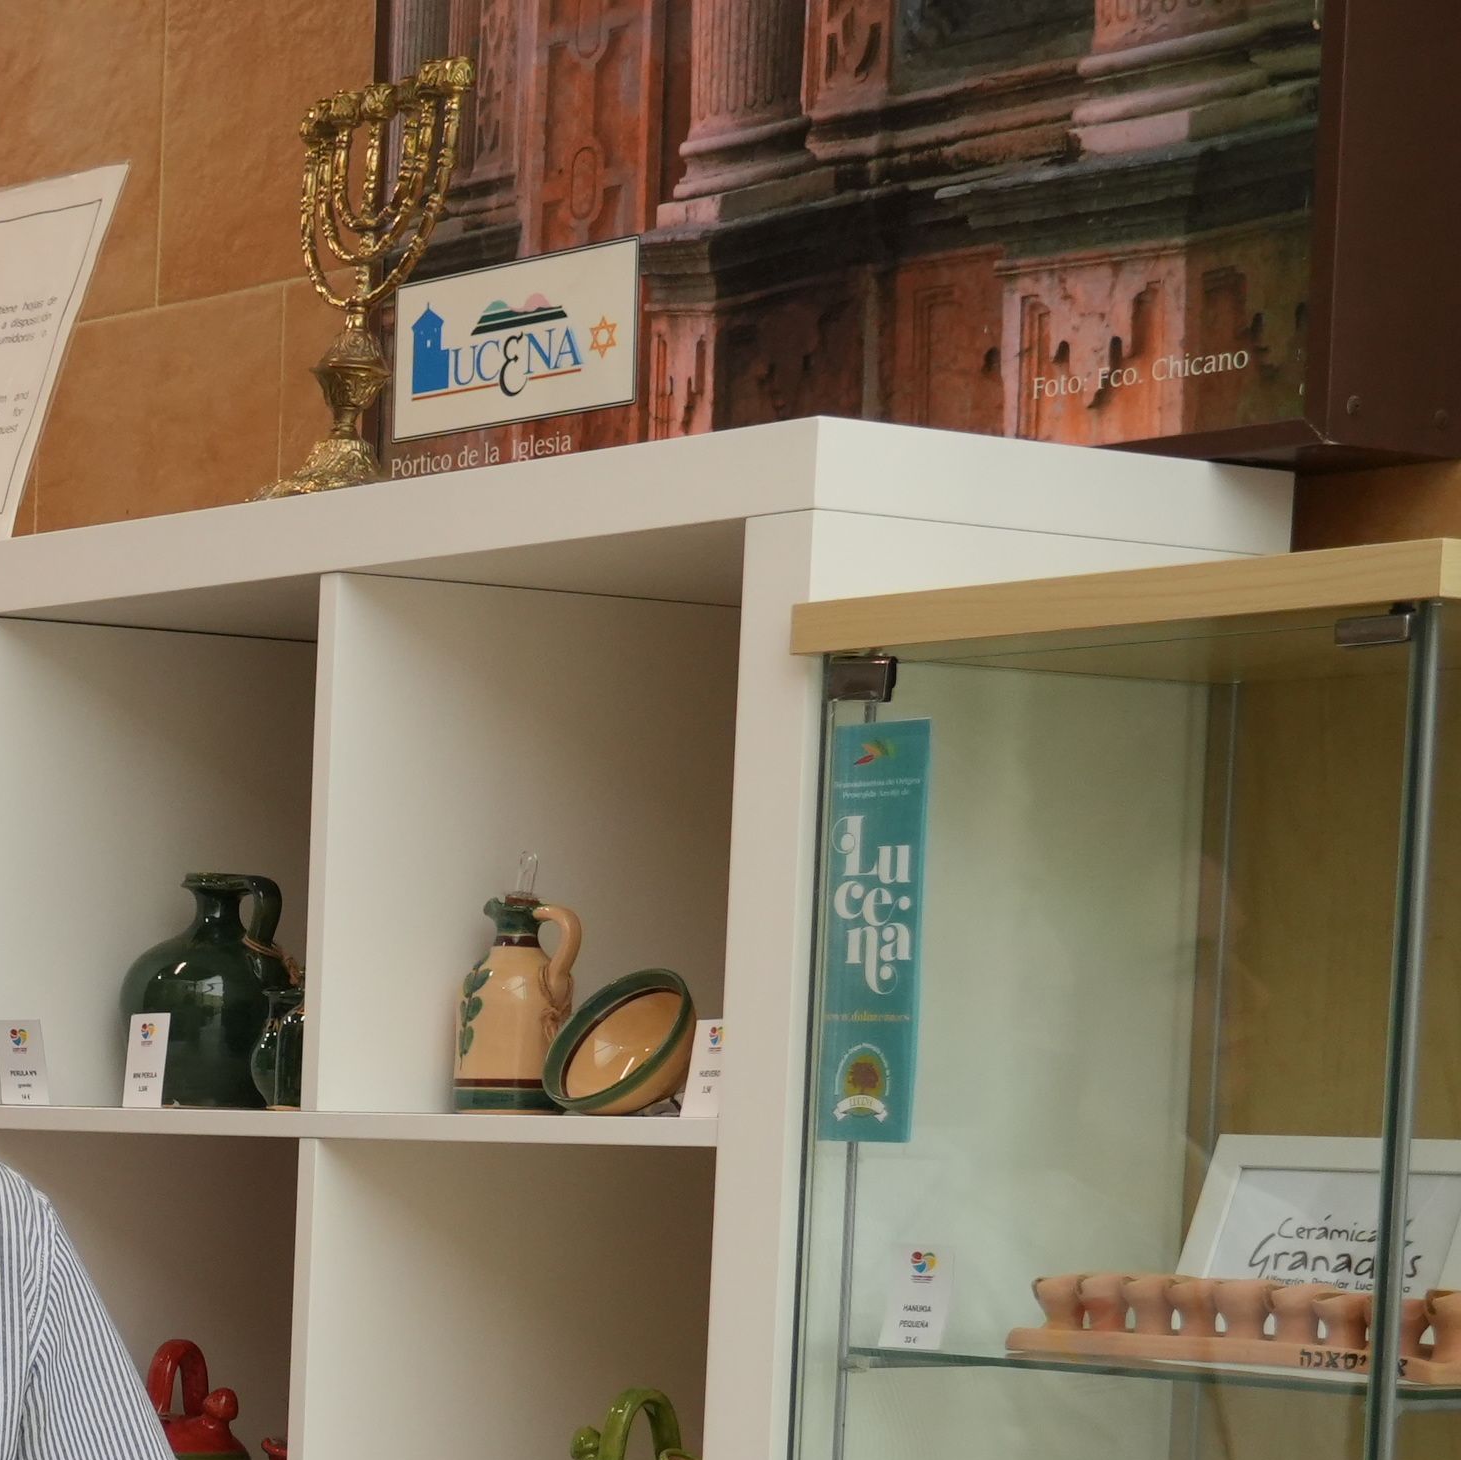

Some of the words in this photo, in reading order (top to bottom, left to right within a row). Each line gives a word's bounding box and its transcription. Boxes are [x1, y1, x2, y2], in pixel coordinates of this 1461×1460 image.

[1033, 375, 1088, 400] Foto:
[1097, 366, 1144, 390] Fco.
[1152, 350, 1249, 382] Chicano
[391, 454, 453, 479] Pórtico
[457, 446, 479, 468] de
[484, 442, 500, 464] la
[511, 432, 572, 464] Iglesia
[1248, 1232, 1422, 1279] Granads
